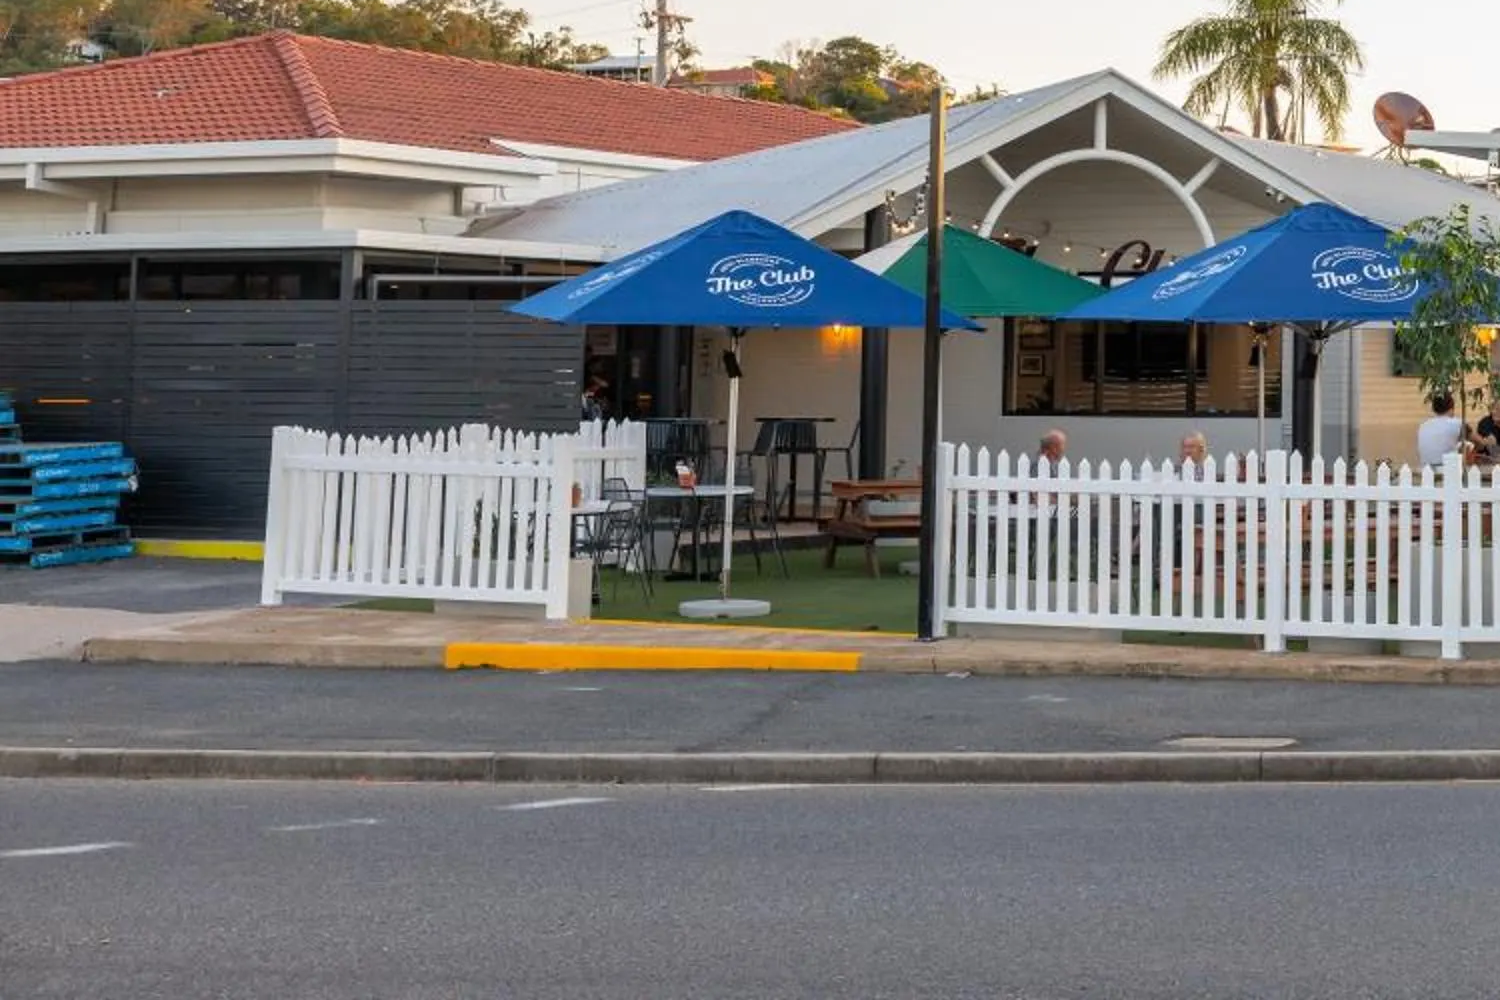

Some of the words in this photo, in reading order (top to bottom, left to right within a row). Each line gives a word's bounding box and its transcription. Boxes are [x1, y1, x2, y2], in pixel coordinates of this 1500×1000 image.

[705, 276, 757, 295] The
[759, 264, 815, 287] Club
[1311, 272, 1362, 289] The
